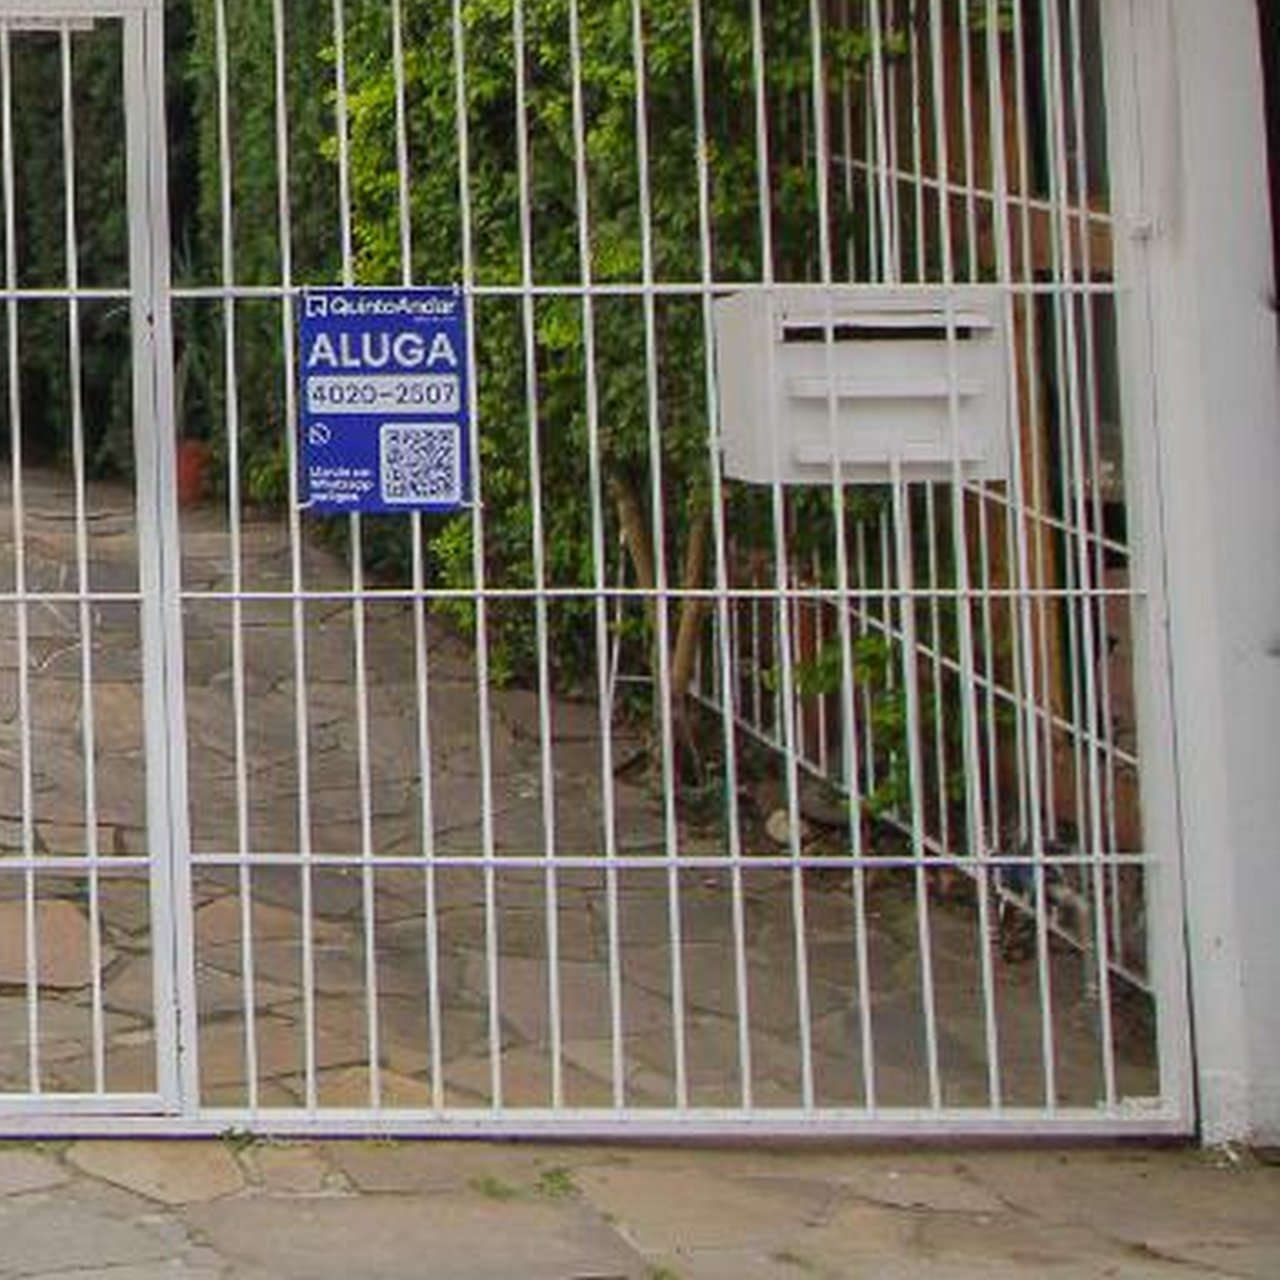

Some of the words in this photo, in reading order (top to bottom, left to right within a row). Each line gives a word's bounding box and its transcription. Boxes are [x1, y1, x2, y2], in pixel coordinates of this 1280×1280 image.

[329, 296, 457, 316] QuintoAndar
[306, 332, 459, 367] ALUGA
[311, 382, 455, 405] 4020-2507
